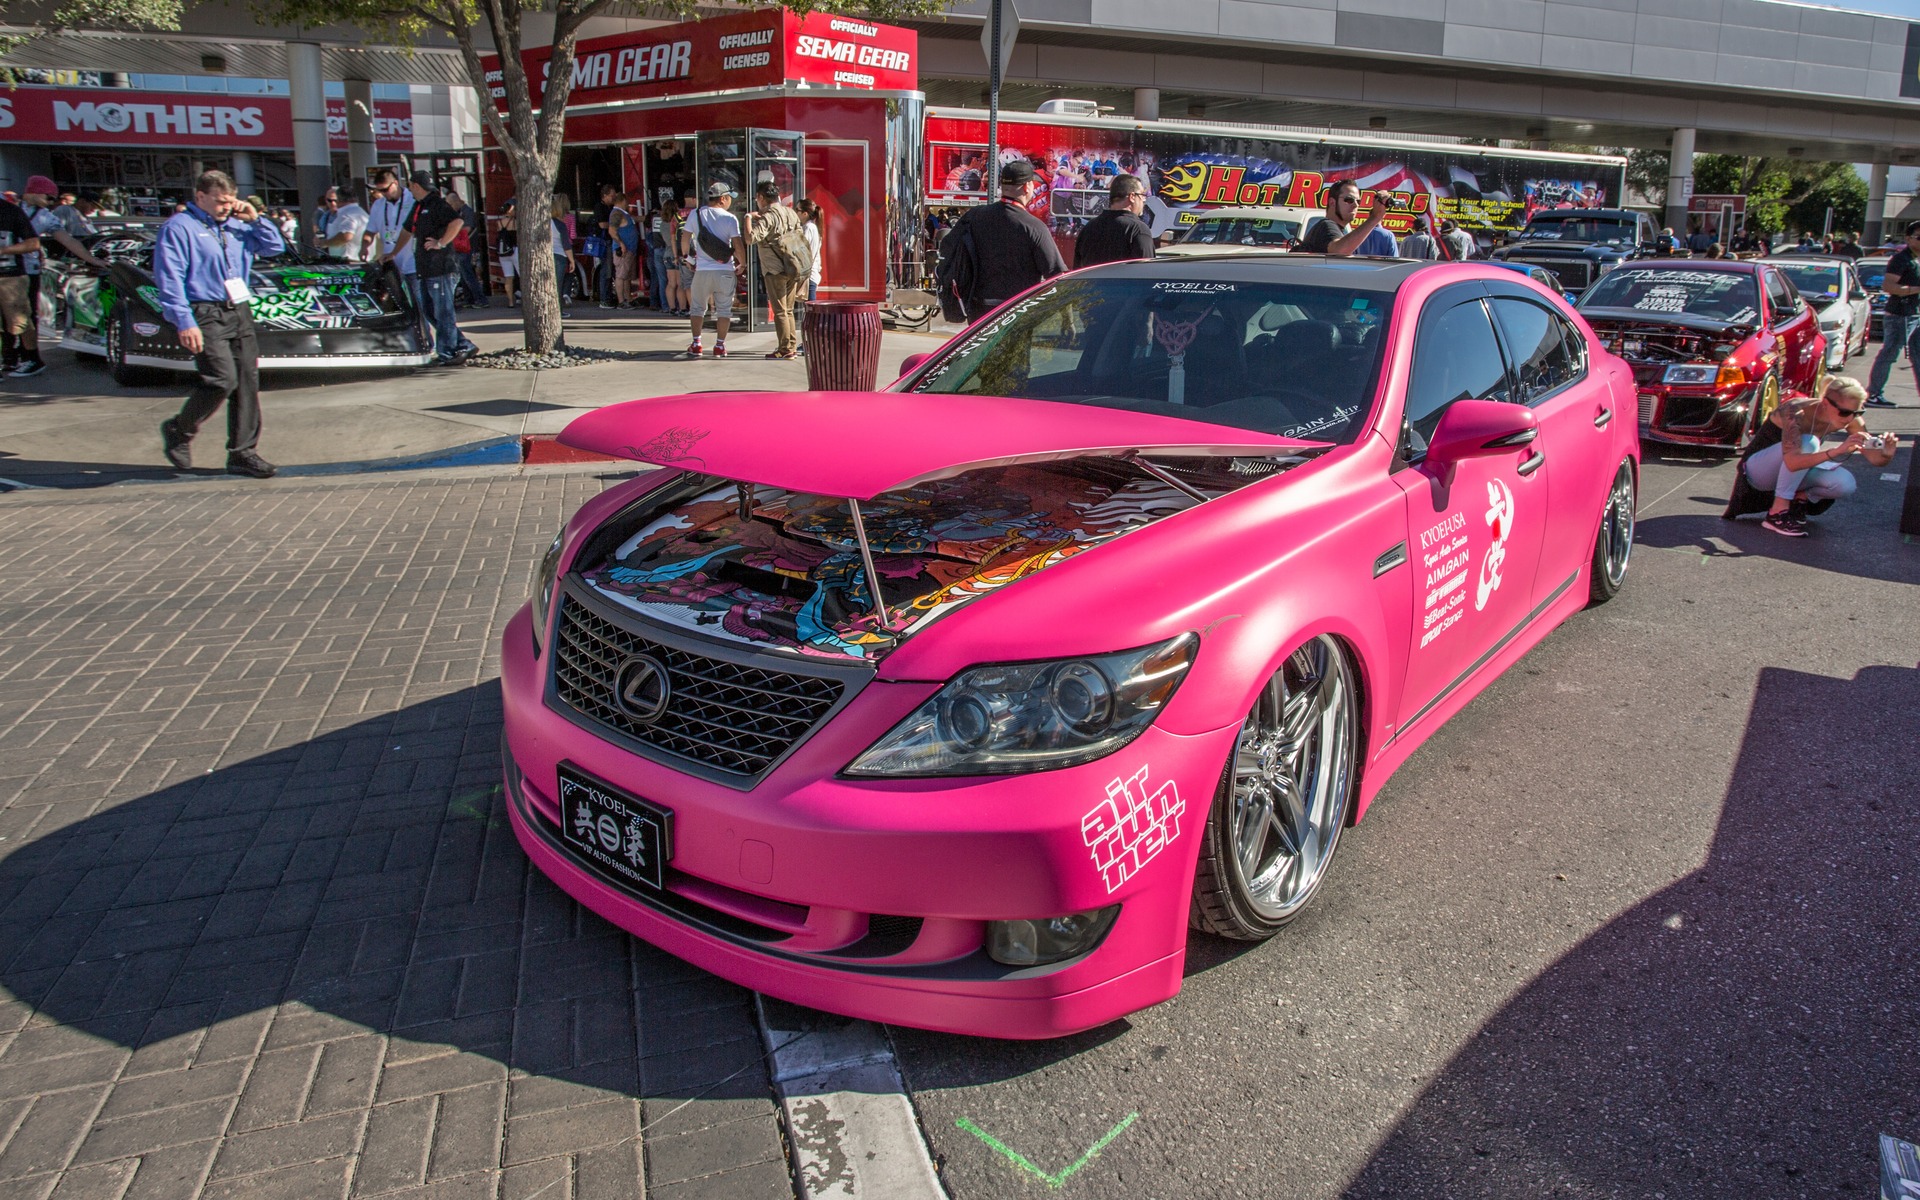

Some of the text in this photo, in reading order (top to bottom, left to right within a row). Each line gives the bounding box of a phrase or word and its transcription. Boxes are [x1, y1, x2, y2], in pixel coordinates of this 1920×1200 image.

[719, 29, 774, 50] OFFICIALLY
[830, 19, 878, 37] OFFICIALLY
[723, 51, 770, 70] LICENSED
[796, 35, 910, 71] SEMA GEAR
[485, 70, 504, 82] OFFIC
[540, 41, 692, 93] SMA GEAR
[834, 71, 875, 86] LICENSED
[53, 100, 266, 136] MOTHERS
[1152, 282, 1236, 292] KYOEI USA
[1425, 548, 1469, 589] AIMGAIN
[588, 786, 628, 817] KYOEI
[582, 842, 641, 882] VIP AUTO FASHION
